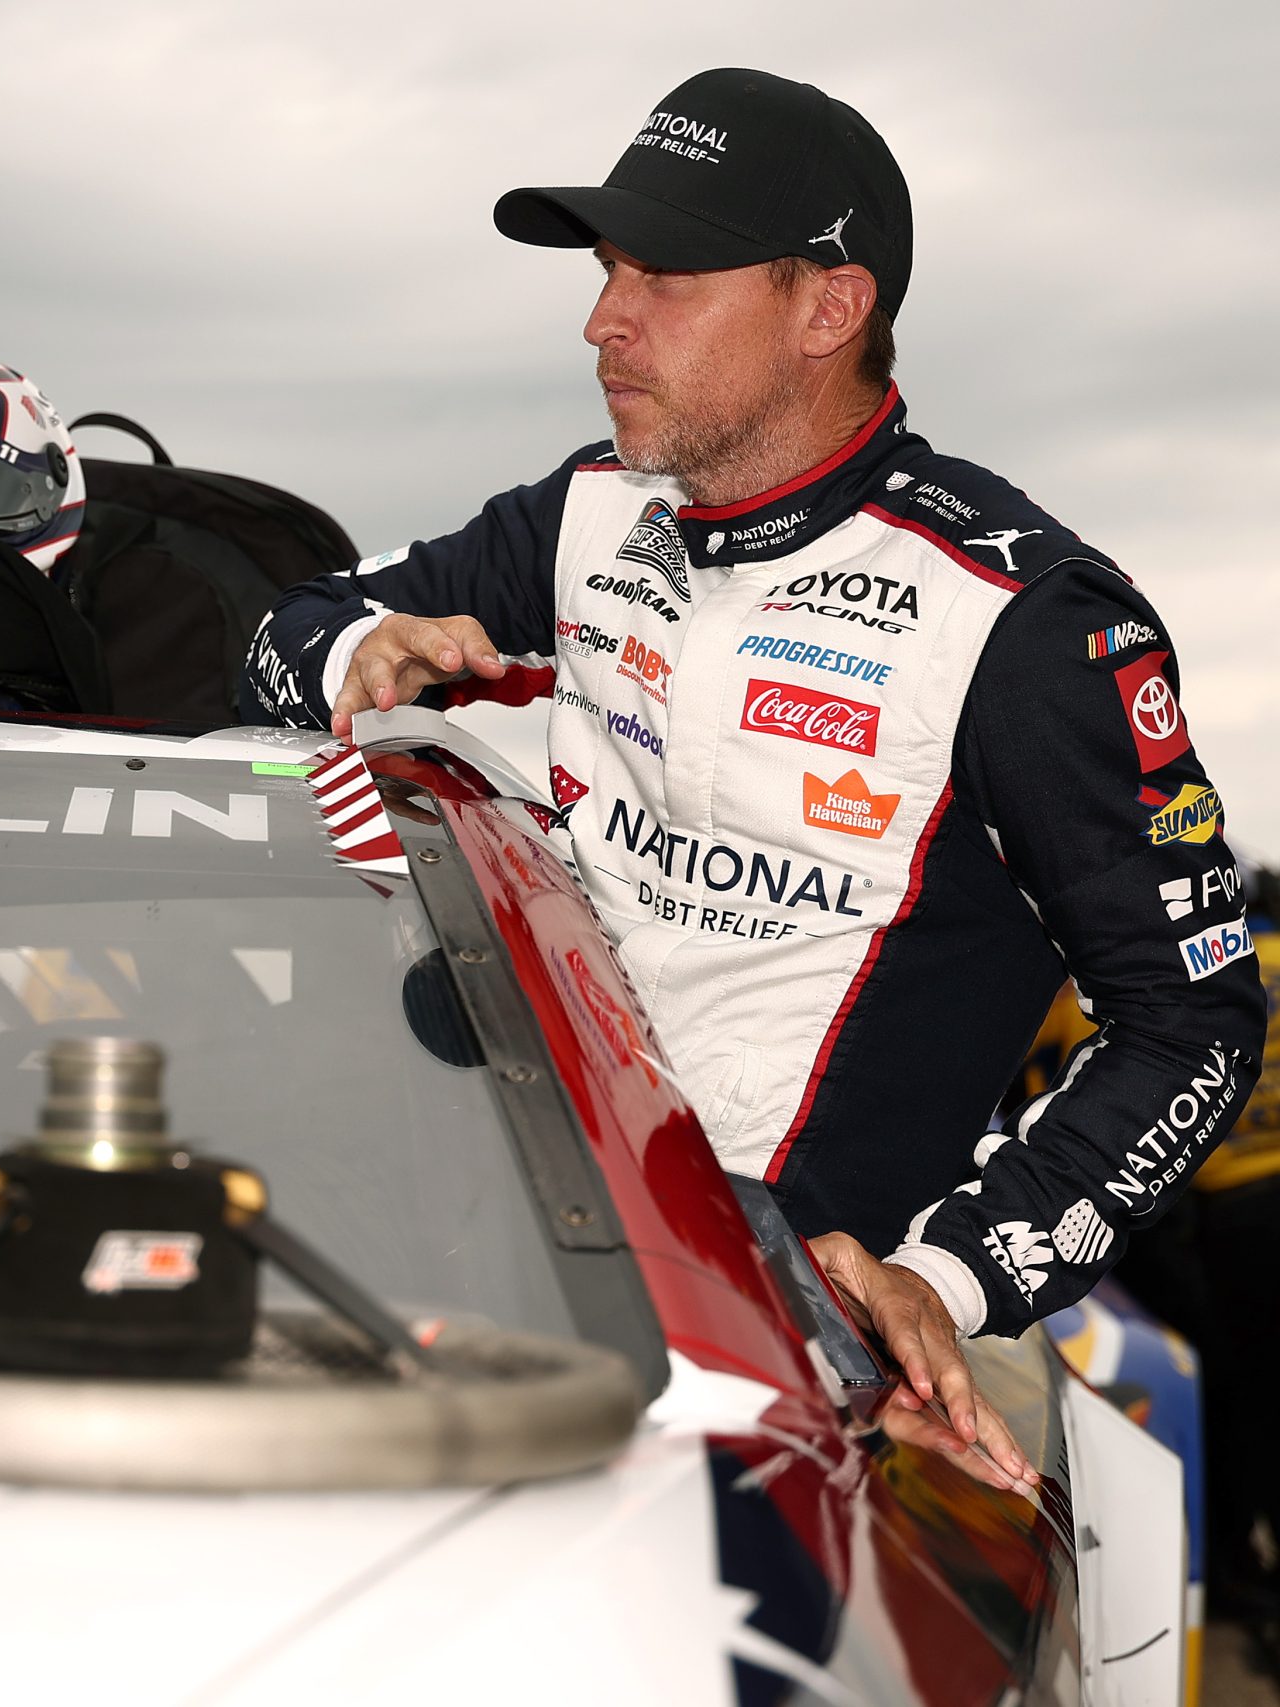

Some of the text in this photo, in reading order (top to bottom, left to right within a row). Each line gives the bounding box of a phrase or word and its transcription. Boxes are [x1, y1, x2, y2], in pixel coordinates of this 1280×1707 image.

[660, 138, 707, 161] RELIEF
[0, 444, 19, 464] 11
[915, 483, 976, 520] NATIONAL
[916, 496, 958, 521] DEBT RELIEF
[732, 510, 807, 542] NATIONAL
[744, 529, 797, 551] DEBT RELIEF
[629, 528, 688, 584] CUP SERIES
[586, 574, 680, 624] GOODYEAR
[755, 601, 917, 635] RACING
[736, 635, 893, 687] PROGRESSIVE
[555, 684, 601, 718] MythWorx
[746, 687, 876, 748] Coca-Cola
[809, 803, 882, 831] Hawaiian
[826, 792, 872, 815] King's
[605, 798, 863, 917] NATIONAL
[638, 880, 799, 940] DEBT RELIEF
[1104, 1048, 1226, 1208] NATIONA
[1148, 1073, 1237, 1197] DEBT RELIEF
